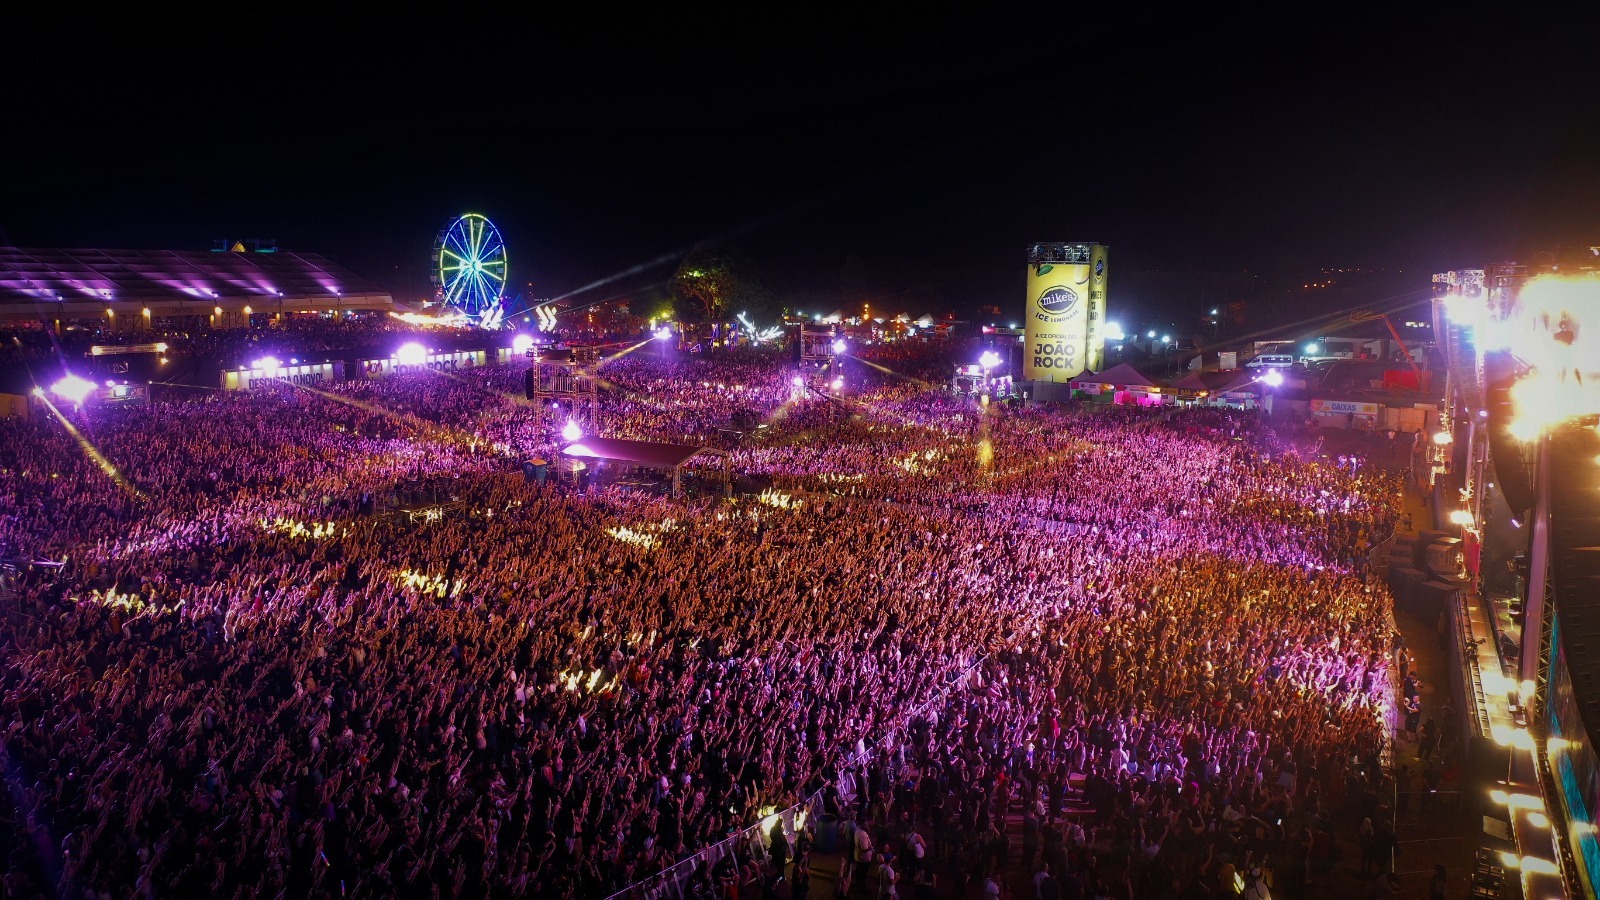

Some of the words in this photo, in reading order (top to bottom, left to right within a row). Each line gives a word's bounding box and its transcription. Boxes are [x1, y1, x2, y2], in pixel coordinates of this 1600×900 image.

[1042, 292, 1074, 306] mike's
[1035, 312, 1049, 322] ICE
[1050, 309, 1079, 323] LEMONADE
[1034, 341, 1075, 356] JOÃO
[427, 359, 460, 374] ROCK
[1033, 356, 1074, 369] ROCK
[249, 375, 292, 390] DESCUBRA
[293, 374, 299, 384] O
[1331, 403, 1357, 412] CAIXAS
